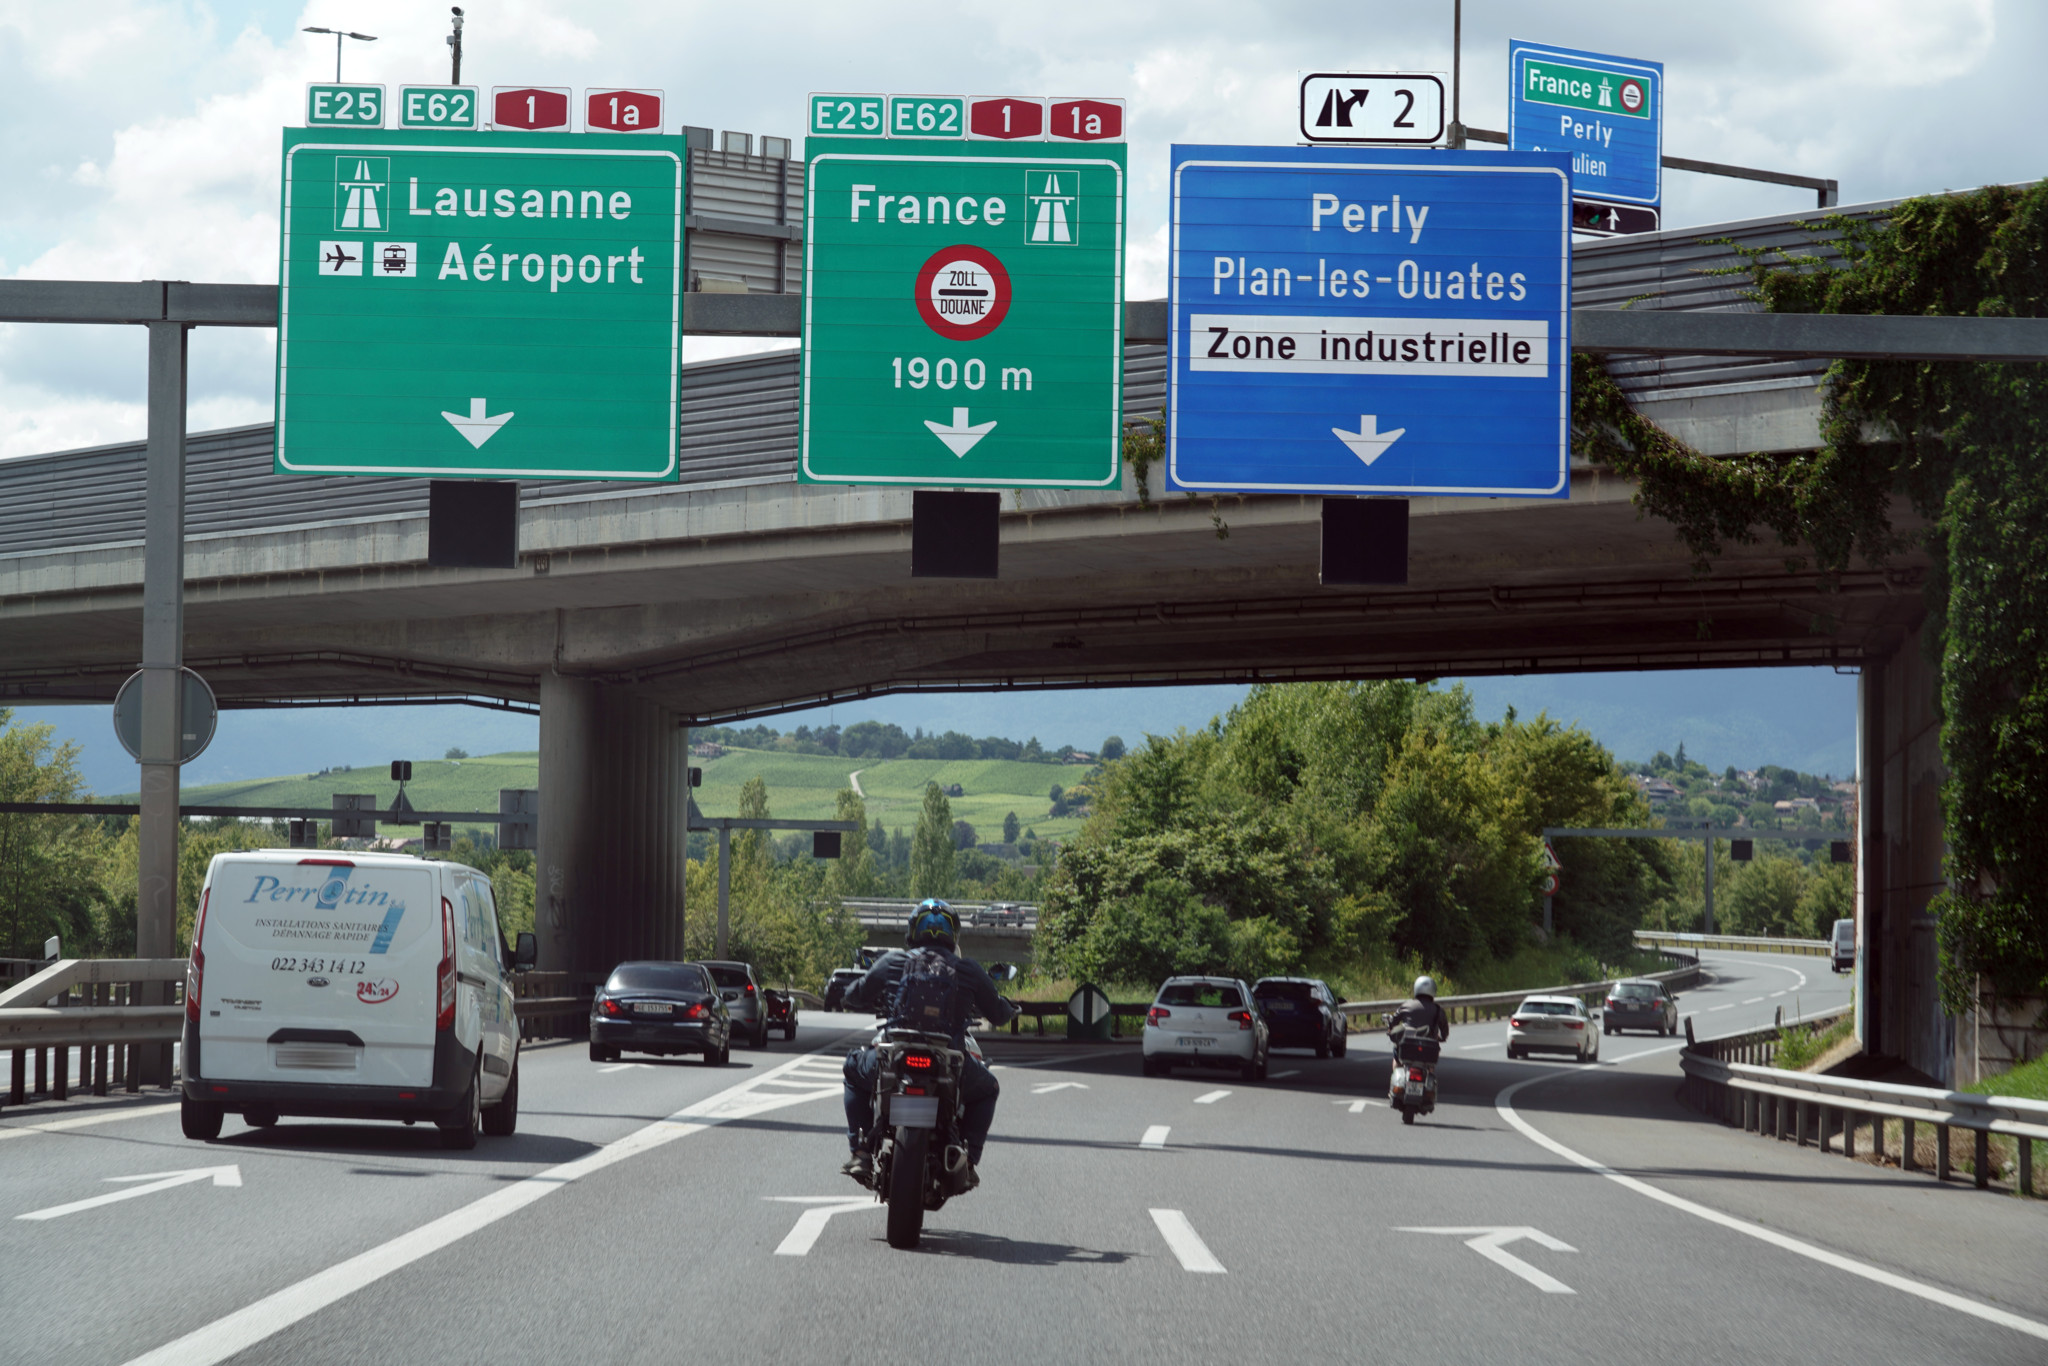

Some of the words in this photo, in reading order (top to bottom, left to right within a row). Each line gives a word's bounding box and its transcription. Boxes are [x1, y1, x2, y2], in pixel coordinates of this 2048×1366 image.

[1529, 68, 1592, 99] France
[314, 92, 377, 120] E25
[408, 94, 469, 122] E62
[526, 95, 536, 122] 1
[609, 98, 639, 125] 1a
[816, 102, 879, 130] E25
[897, 103, 957, 131] E62
[1002, 105, 1011, 132] 1
[1393, 90, 1415, 128] 2
[1072, 107, 1101, 134] 1a
[1561, 114, 1613, 148] Perly
[409, 177, 632, 220] Lausanne
[851, 184, 1006, 225] France
[1313, 193, 1429, 243] Perly
[438, 242, 645, 292] Aéroport
[949, 271, 977, 286] ZOLL
[1214, 257, 1527, 301] Plan-les-Ouates
[940, 299, 986, 315] DOUANE
[1208, 327, 1296, 360] Zone
[1321, 330, 1531, 364] industrielle
[892, 357, 986, 390] 1900
[1002, 367, 1033, 391] m
[255, 918, 330, 930] INSTALLATIONS
[333, 921, 389, 932] SANITAIRES
[272, 928, 331, 940] DÉPANNAGE
[333, 932, 370, 942] RAPIDE
[271, 957, 296, 972] 022
[299, 958, 325, 974] 343
[329, 960, 346, 974] 14
[349, 960, 366, 975] 12
